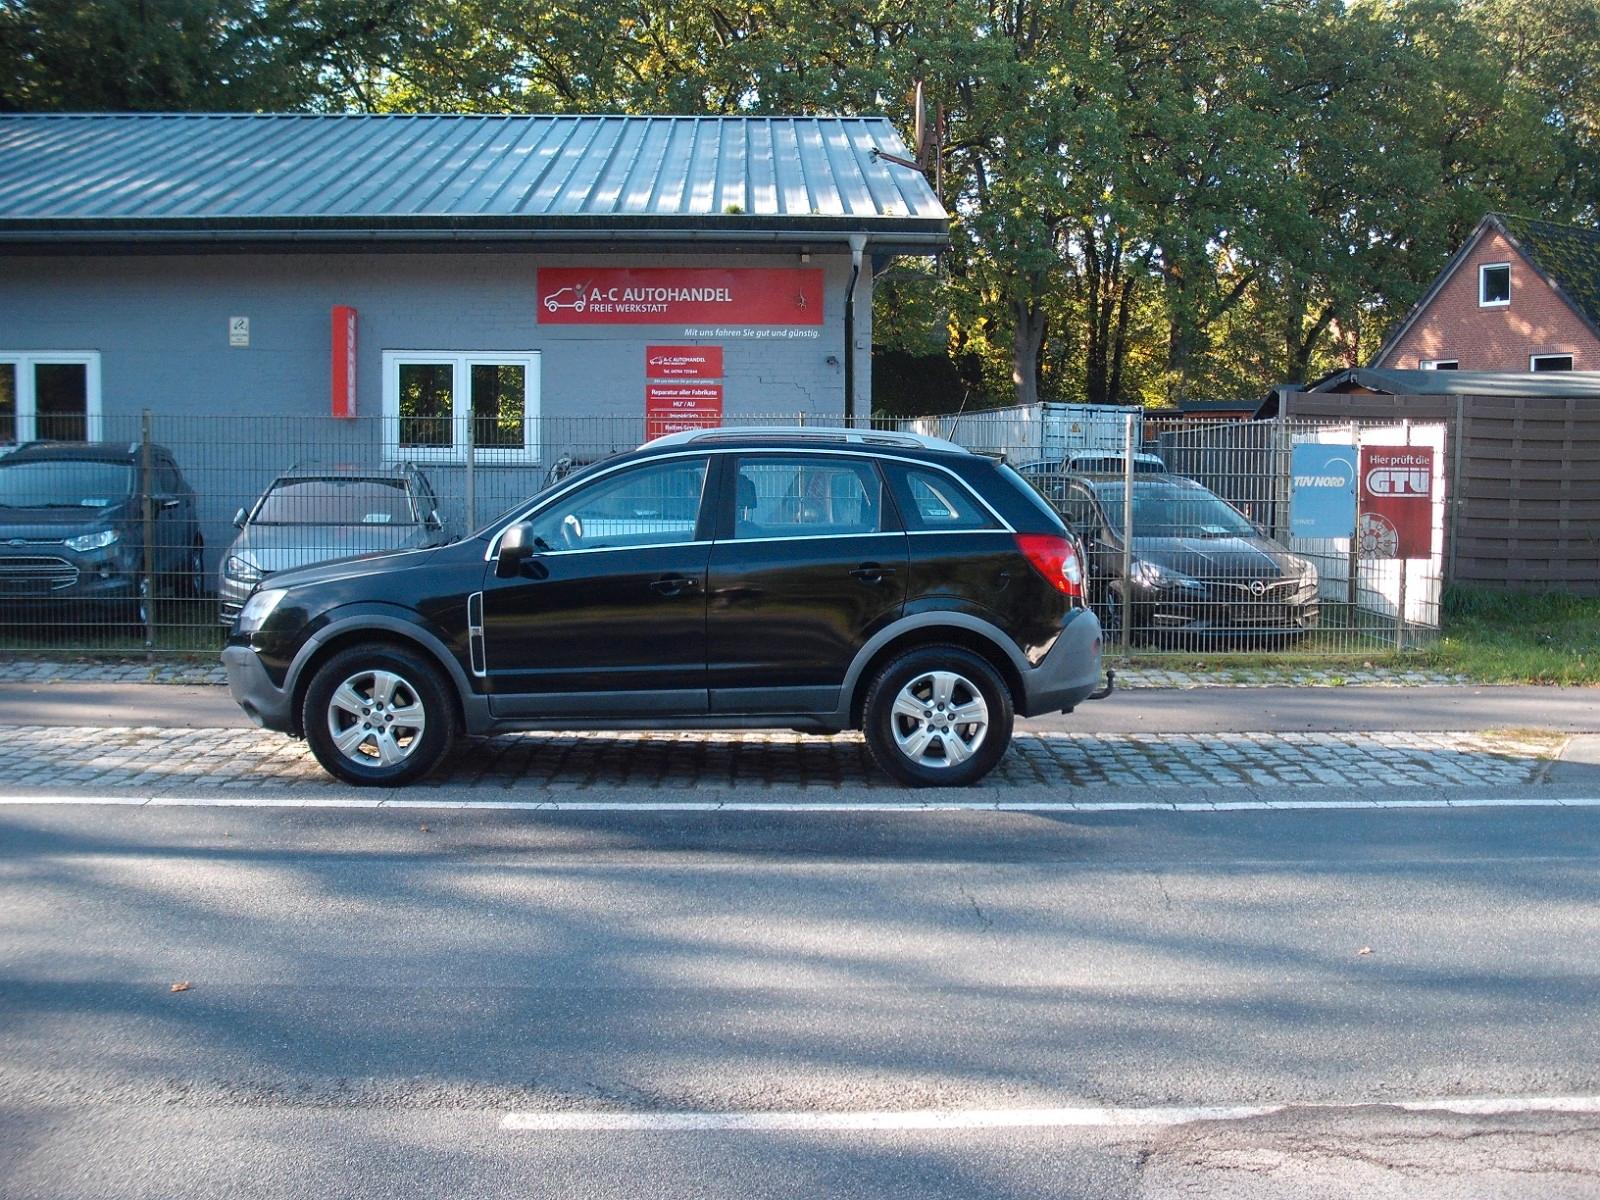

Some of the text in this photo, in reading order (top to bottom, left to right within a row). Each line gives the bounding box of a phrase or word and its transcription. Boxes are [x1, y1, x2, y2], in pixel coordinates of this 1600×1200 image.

[590, 288, 733, 302] A-C AUTOHANDEL
[590, 304, 668, 313] FREIE WERKSTATT
[684, 328, 698, 337] Mit
[715, 328, 742, 337] fahren
[743, 328, 755, 337] Sie
[756, 329, 770, 339] gut
[771, 328, 787, 337] und
[788, 328, 820, 339] günstig.
[1370, 455, 1430, 466] Hier prüft die
[1315, 476, 1345, 487] NORD
